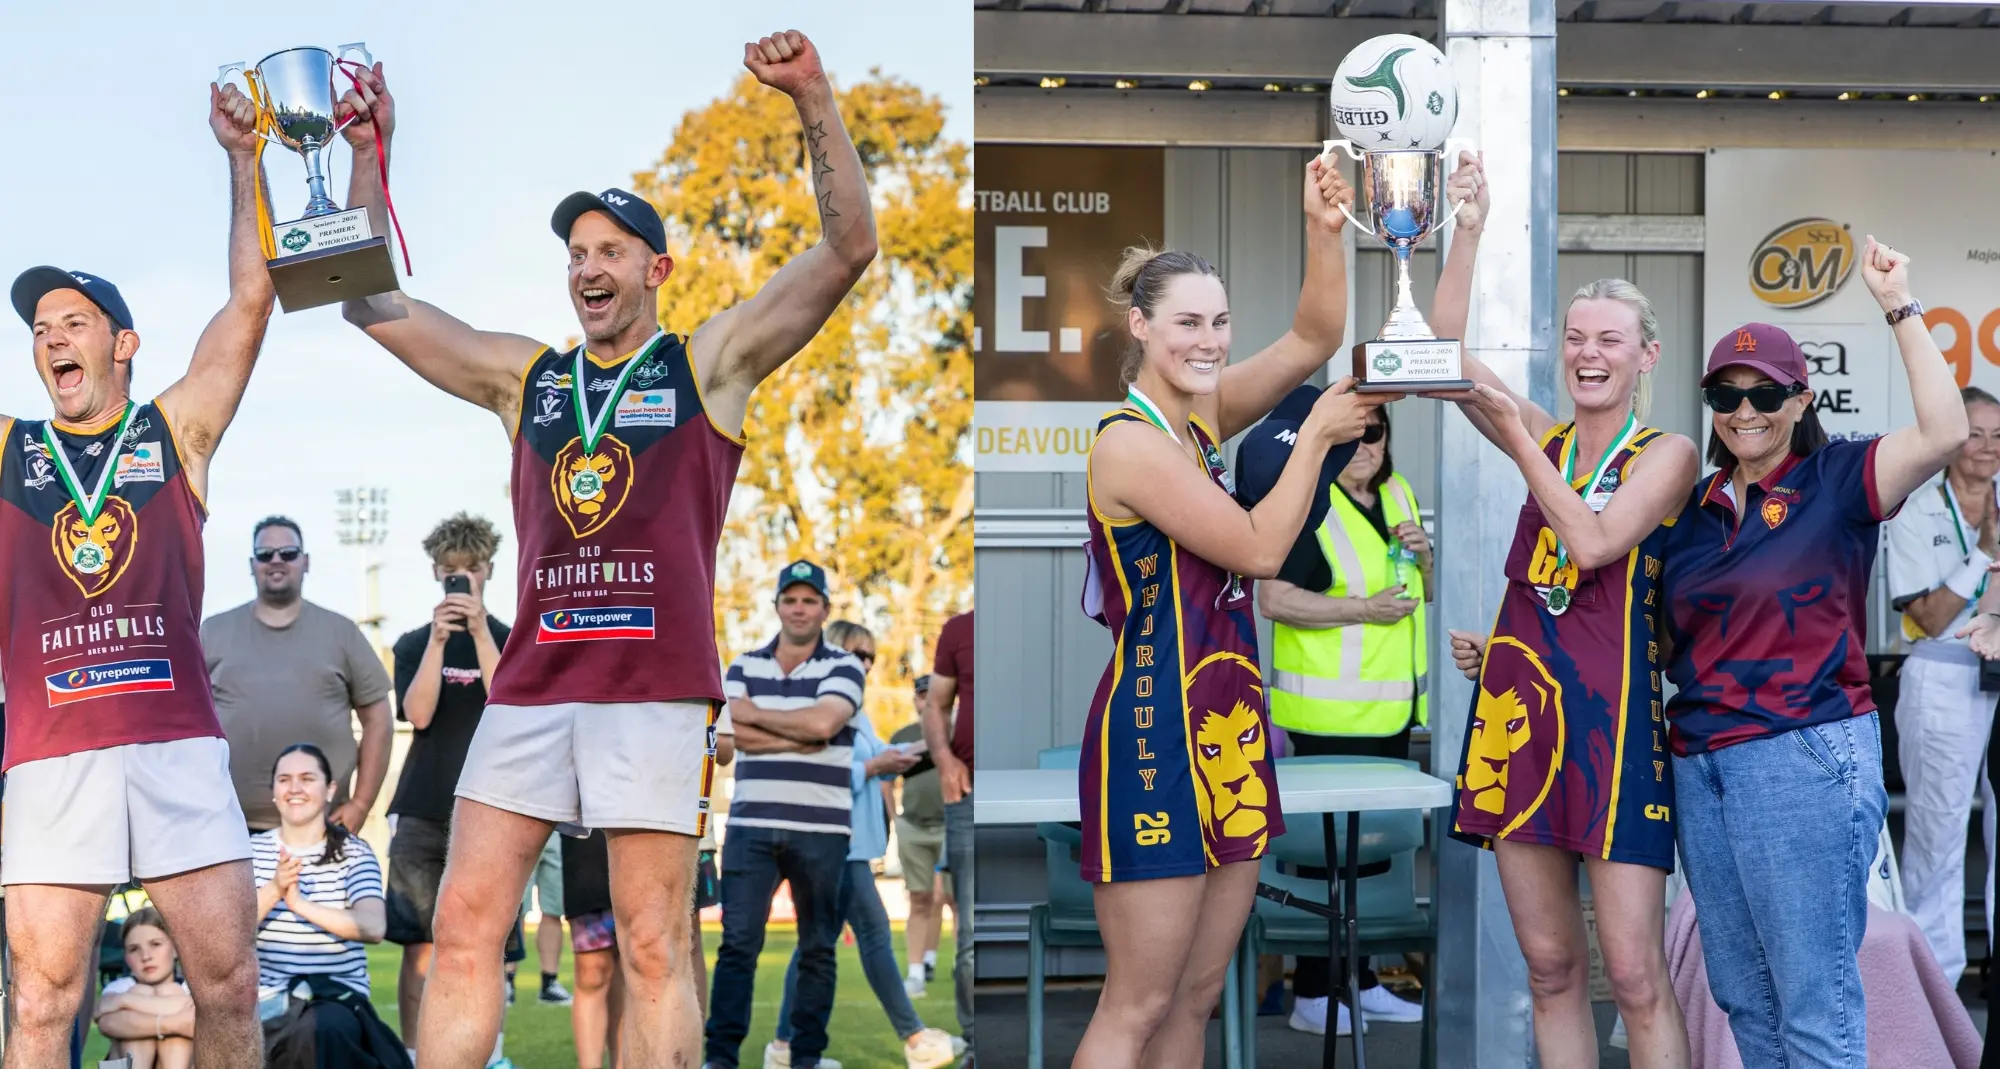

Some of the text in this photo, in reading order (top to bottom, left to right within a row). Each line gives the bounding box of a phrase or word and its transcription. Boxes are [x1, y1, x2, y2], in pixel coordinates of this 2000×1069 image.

[974, 190, 1110, 214] TBALL CLUB
[313, 219, 336, 229] Seniors
[341, 215, 358, 224] 2026
[319, 225, 356, 238] PREMIERS
[286, 234, 307, 246] O&K
[317, 234, 361, 247] WHOROULY
[1966, 248, 2000, 264] Majo
[1753, 245, 1843, 291] O&M
[1733, 329, 1758, 353] LA
[1376, 358, 1399, 368] O&K
[1407, 367, 1450, 375] WHOROULY
[1812, 389, 1860, 414] AE.
[977, 426, 1098, 456] DEAVOU
[579, 545, 601, 558] OLD
[594, 589, 608, 597] BAR
[90, 603, 113, 618] OLD
[572, 613, 632, 626] Tyrepower
[87, 644, 125, 656] BREW BAR
[88, 665, 151, 682] Tyrepower
[1644, 803, 1670, 823] 5
[1134, 811, 1171, 846] 26
